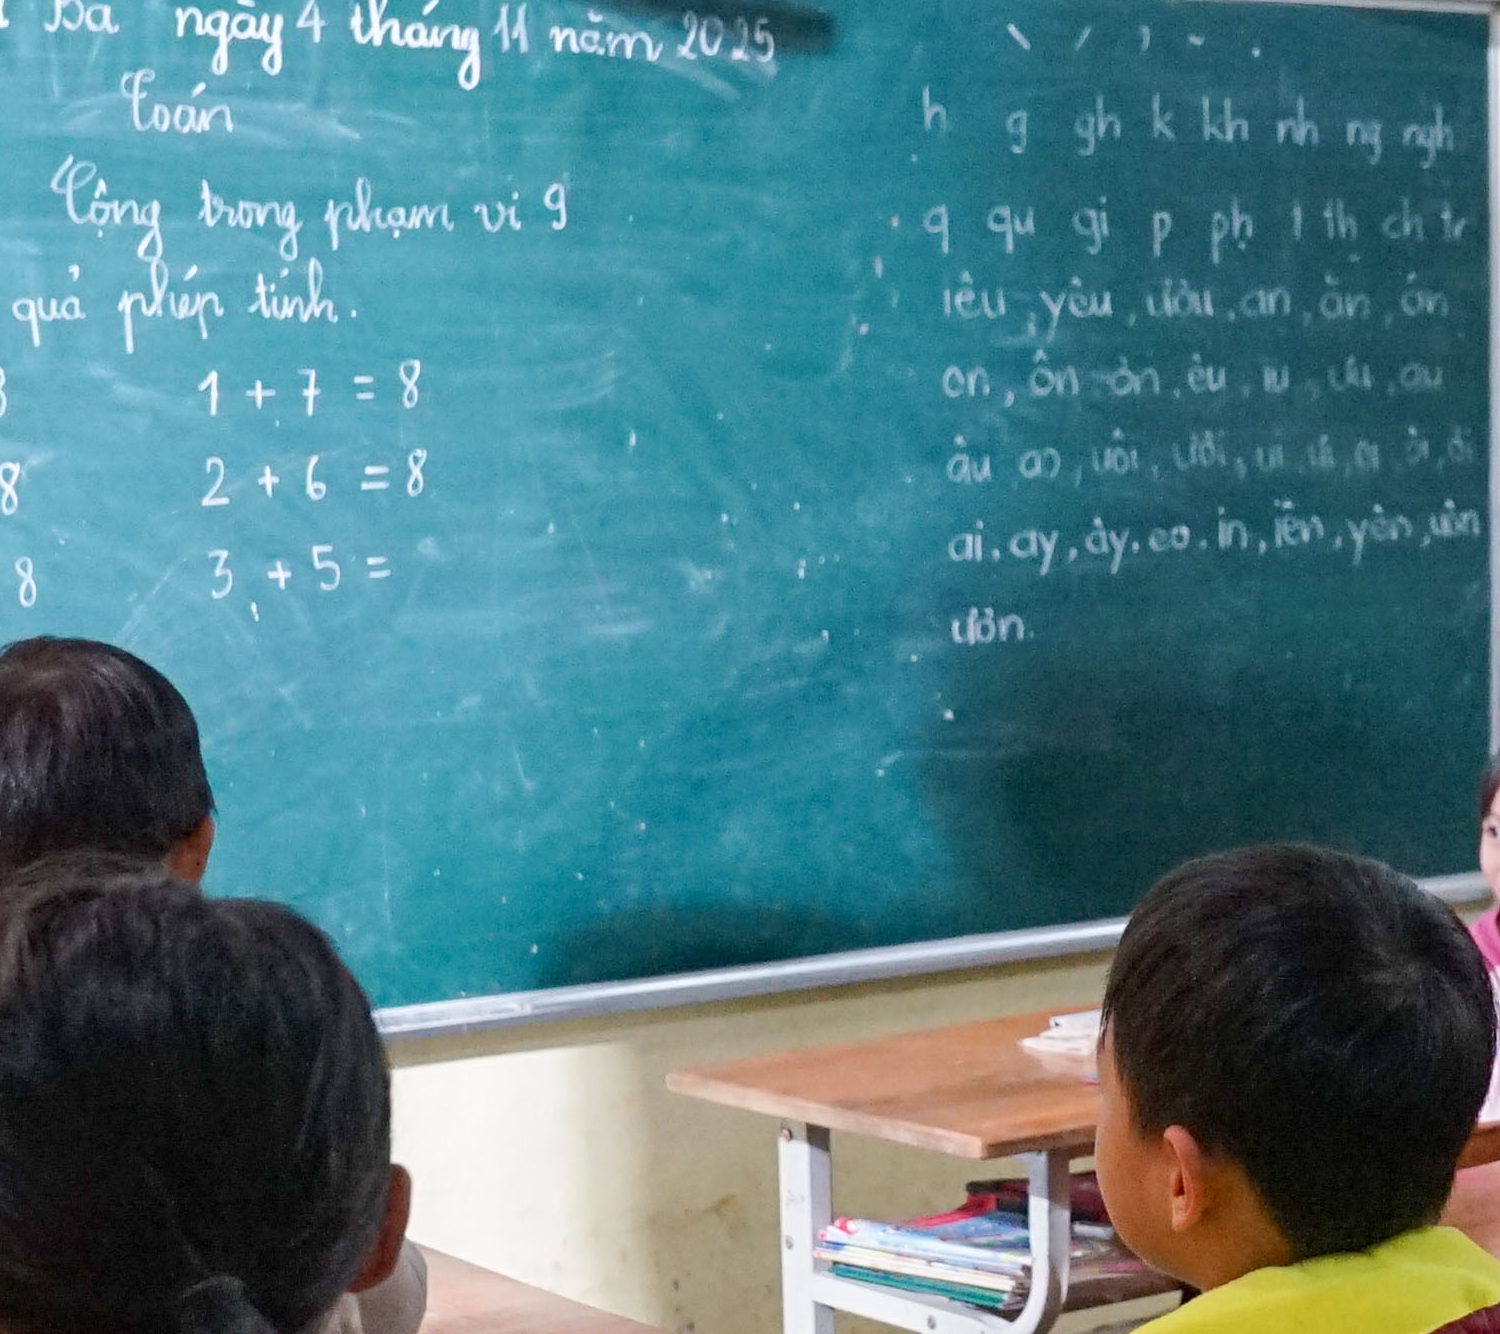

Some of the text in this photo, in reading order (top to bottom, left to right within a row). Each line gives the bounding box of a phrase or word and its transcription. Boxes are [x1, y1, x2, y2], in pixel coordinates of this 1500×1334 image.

[494, 3, 528, 53] 11
[549, 10, 663, 61] năm
[675, 10, 776, 64] 2025
[121, 69, 233, 133] Toán
[923, 85, 1454, 169] h g gh k kh nh ng ngh
[51, 155, 566, 265] Cộng trong phạm vi 9
[12, 264, 85, 347] quả
[118, 246, 223, 354] phép
[248, 257, 356, 323] tính.
[198, 360, 420, 416] 1 + 7 = 8
[202, 449, 427, 506] 2 + 6 = 8
